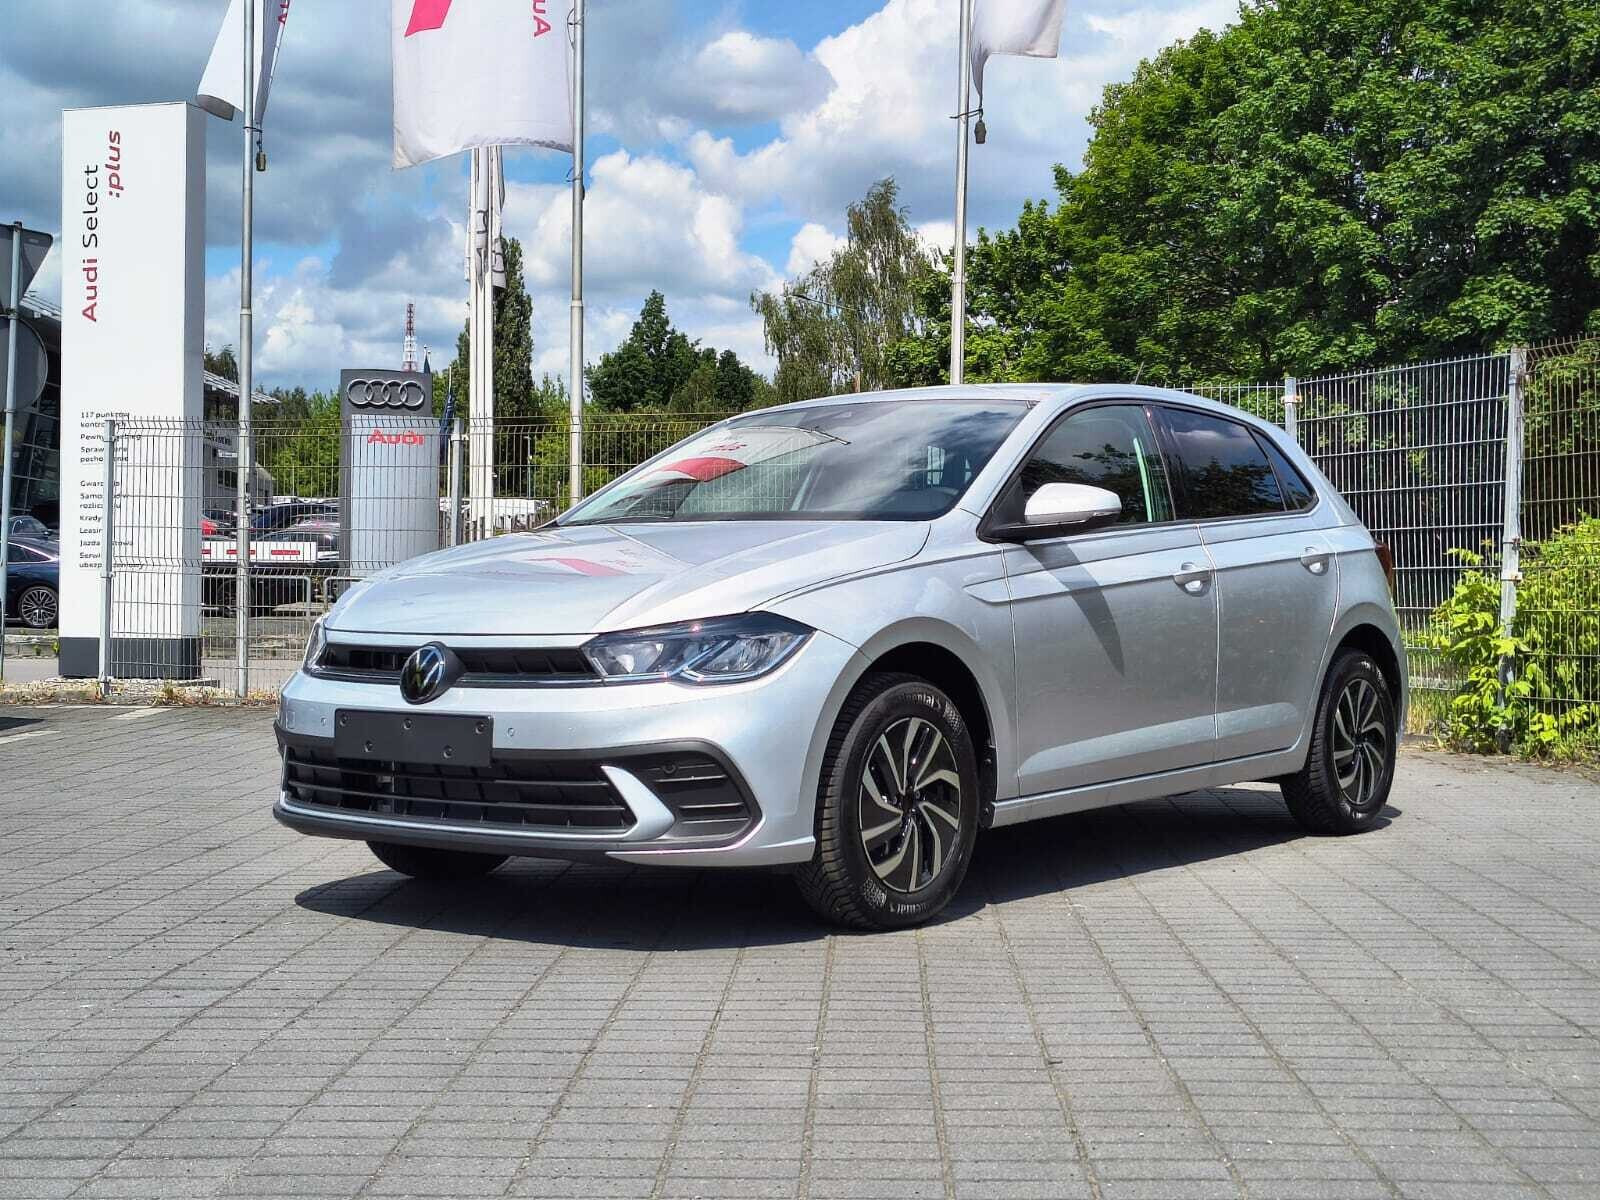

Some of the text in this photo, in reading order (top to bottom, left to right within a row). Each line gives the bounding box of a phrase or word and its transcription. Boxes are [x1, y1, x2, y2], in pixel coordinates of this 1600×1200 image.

[105, 130, 124, 198] :plus
[82, 164, 99, 322] Audi Select
